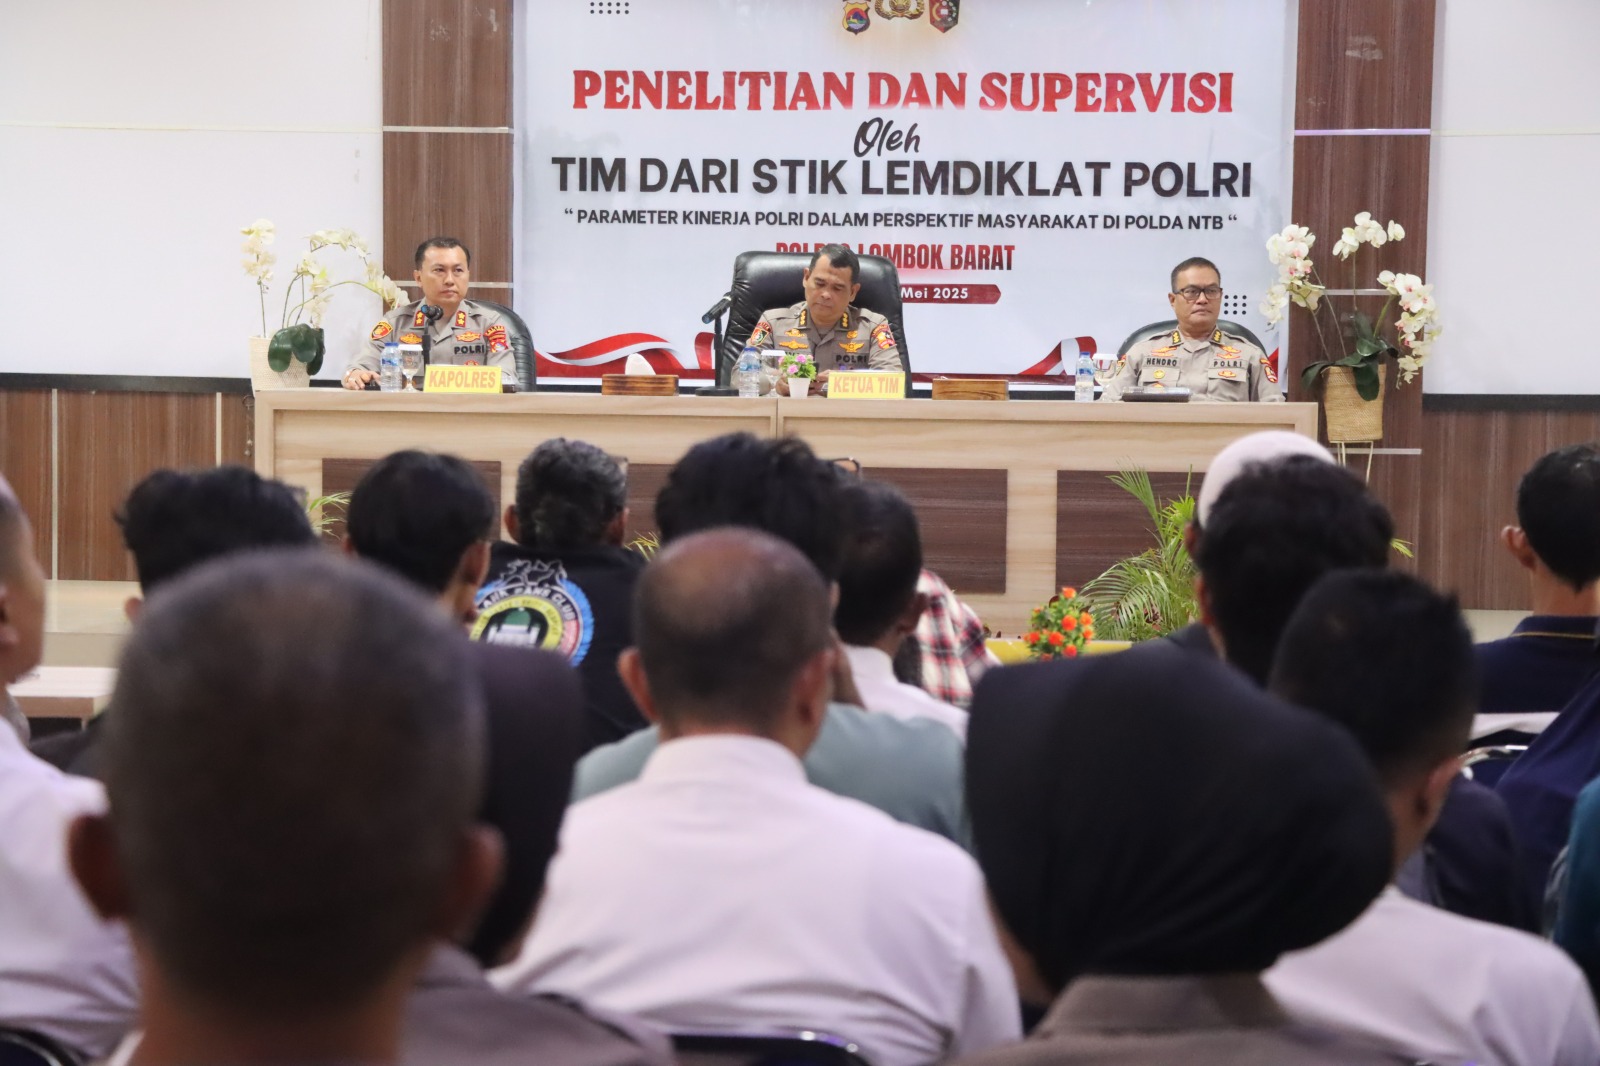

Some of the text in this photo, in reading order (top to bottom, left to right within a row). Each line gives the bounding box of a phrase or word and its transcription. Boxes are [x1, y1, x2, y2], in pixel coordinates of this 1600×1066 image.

[573, 70, 1234, 113] PENELITIAN DAN SUPERVISI
[853, 117, 921, 158] Oleh
[552, 157, 1252, 198] TIM DARI STIK LEMDIKLAT POLRI
[577, 210, 678, 225] PARAMETER
[683, 211, 751, 226] KINERJA
[755, 212, 804, 226] POLRI
[808, 212, 869, 227] DALAM
[873, 213, 974, 228] PERSPEKTIF
[977, 214, 1099, 229] MASYARAKAT
[1103, 215, 1120, 229] DI
[1124, 215, 1184, 230] POLDA
[1188, 216, 1224, 230] NTB
[949, 244, 1016, 271] BARAT
[900, 287, 968, 299] Mei 2025
[454, 344, 485, 355] POLRI
[835, 354, 868, 364] POLRI
[1146, 357, 1178, 367] HENDRO
[1213, 360, 1242, 368] POLRI
[428, 370, 497, 389] KAPOLRES
[833, 376, 900, 394] KETUA TIM
